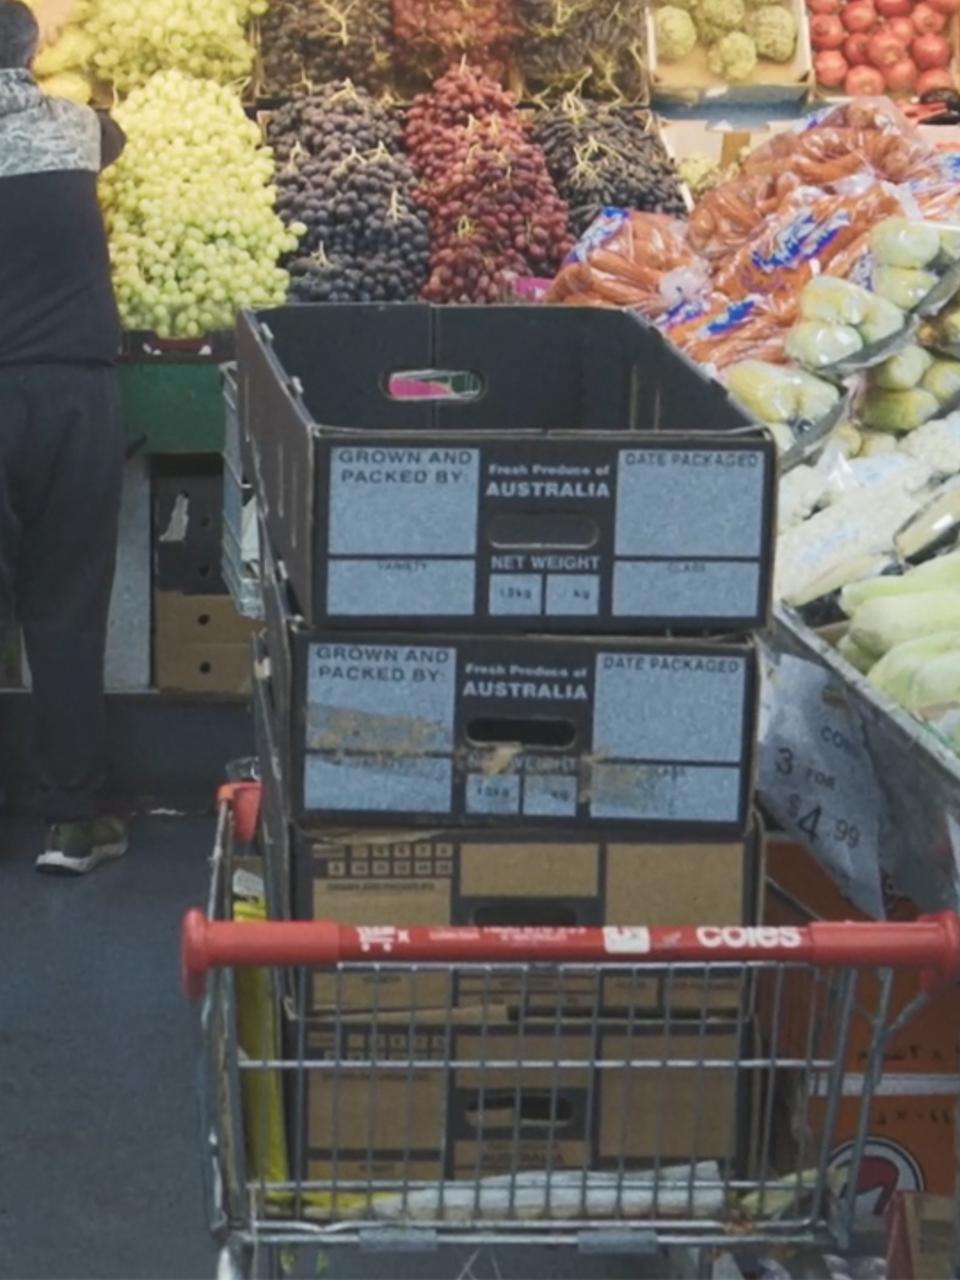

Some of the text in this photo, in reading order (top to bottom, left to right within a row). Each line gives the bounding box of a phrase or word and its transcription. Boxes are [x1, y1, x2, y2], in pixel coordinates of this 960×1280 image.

[338, 450, 473, 466] GROWN AND
[624, 453, 759, 468] DATE PACKAGED
[341, 469, 428, 485] PACKED
[488, 463, 611, 477] Fresh Produce of
[485, 481, 610, 498] AUSTRALIA
[490, 554, 601, 571] NET WEIGHT
[316, 646, 450, 664] GROWN AND
[464, 662, 588, 678] Fresh Produce of
[602, 655, 739, 673] DATE PACKAGED
[318, 666, 406, 682] PACKED
[462, 682, 588, 700] AUSTRALIA
[775, 747, 795, 776] 3
[695, 926, 802, 949] coles
